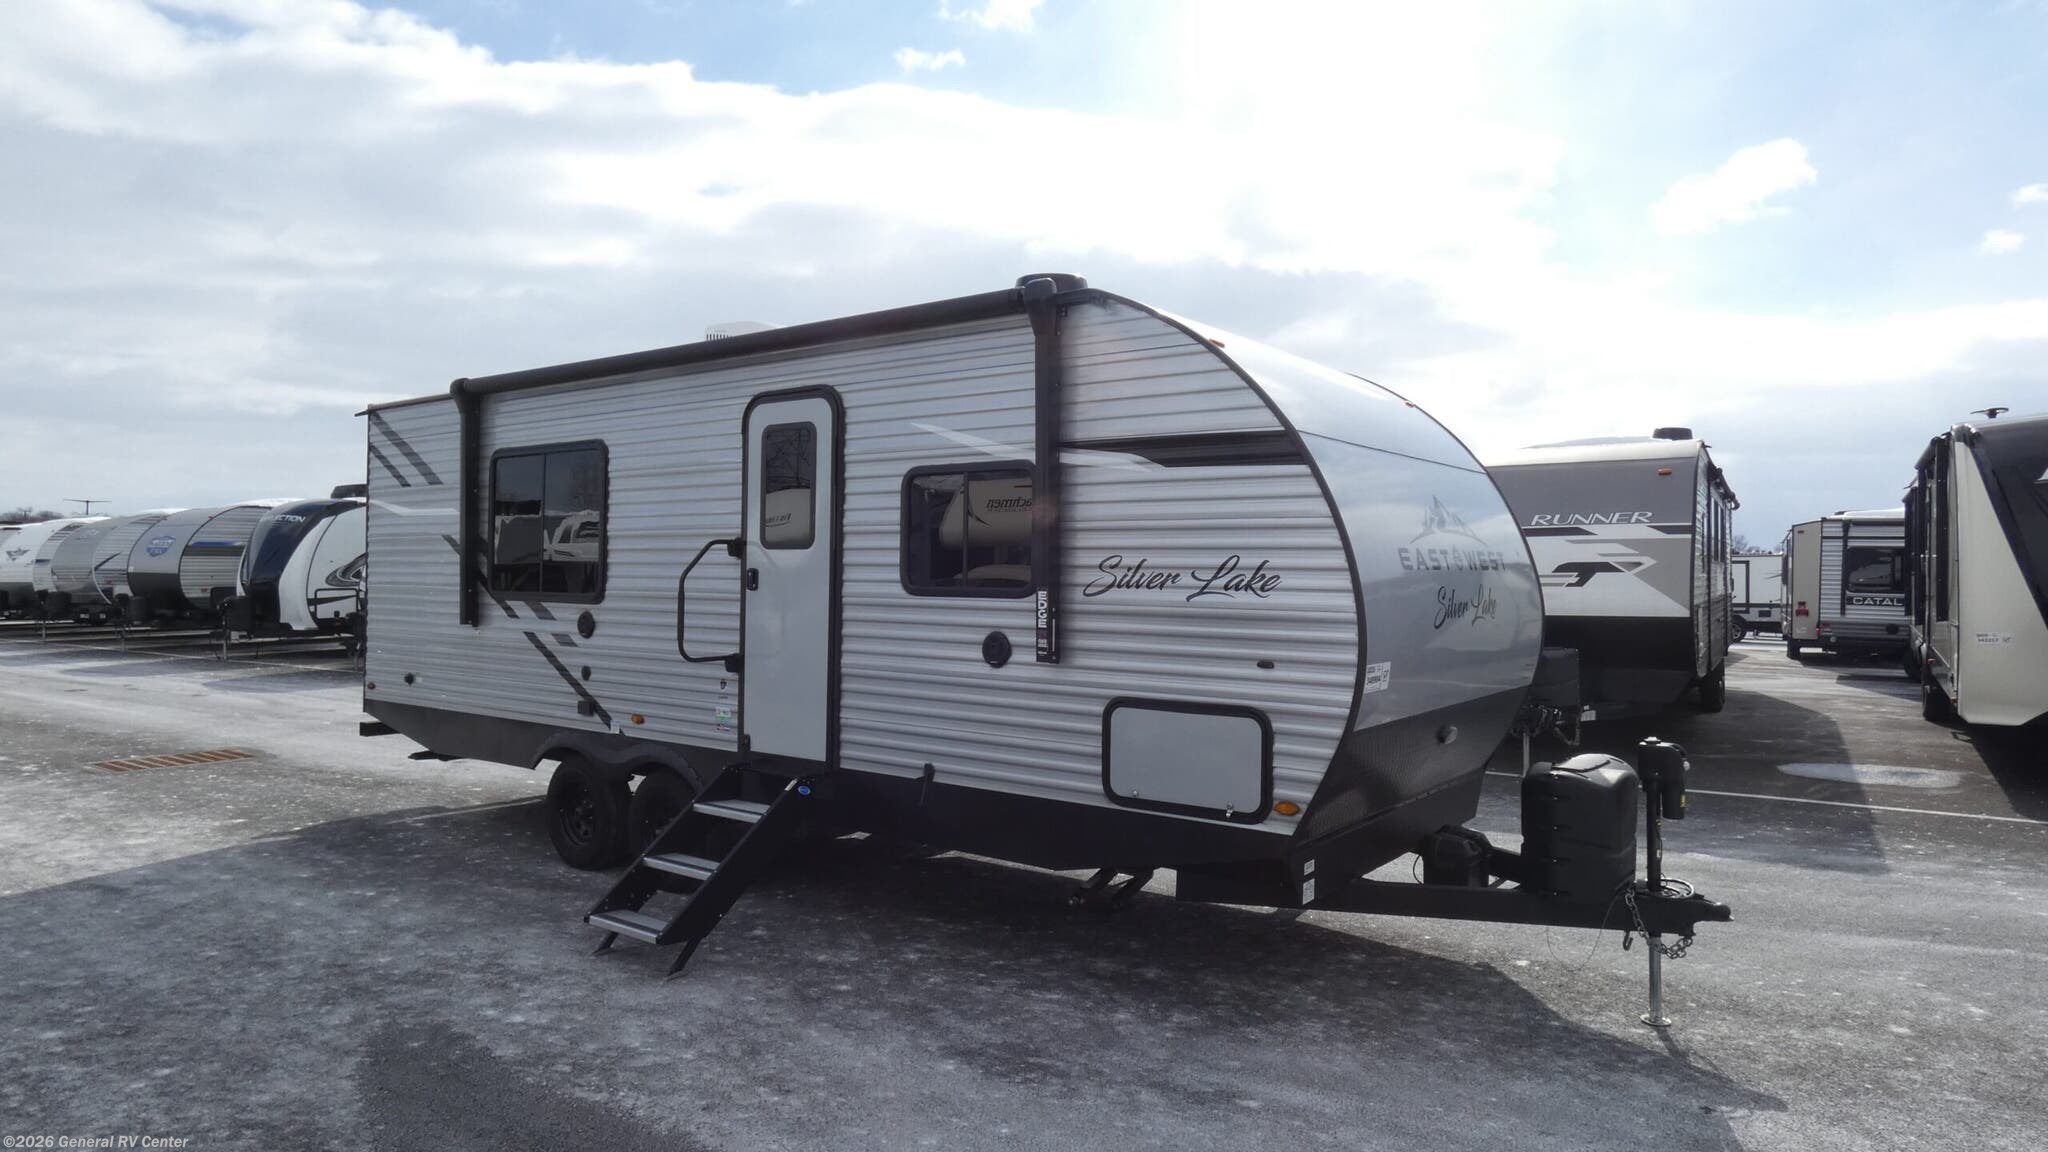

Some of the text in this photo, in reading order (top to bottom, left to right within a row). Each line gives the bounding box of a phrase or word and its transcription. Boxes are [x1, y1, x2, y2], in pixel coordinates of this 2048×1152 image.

[1531, 511, 1653, 526] RUNNER
[1398, 548, 1449, 571] EAST
[1462, 550, 1506, 571] WEST
[1082, 554, 1281, 602] Silver Lake
[1038, 590, 1048, 629] EDGE
[1433, 583, 1497, 629] Silver Lake
[1852, 597, 1904, 606] CATAL
